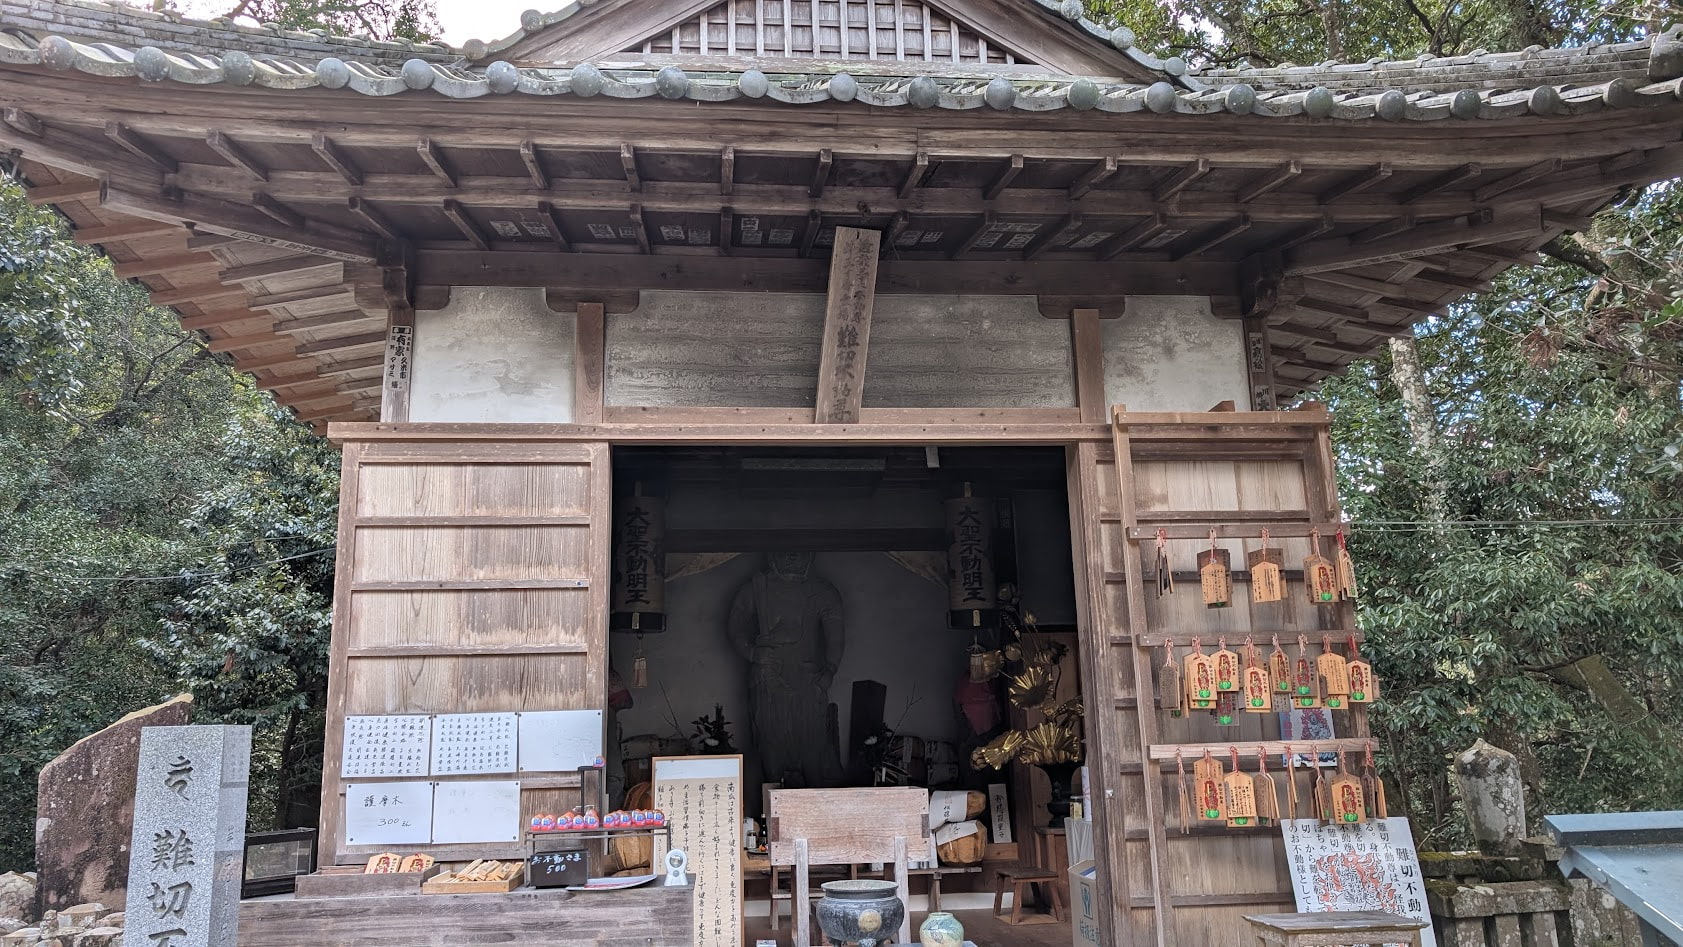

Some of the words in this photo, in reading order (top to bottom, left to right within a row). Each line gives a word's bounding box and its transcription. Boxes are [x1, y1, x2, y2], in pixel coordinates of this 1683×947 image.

[625, 506, 650, 605] 大聖不動明王
[958, 505, 986, 603] 大聖不動明王
[363, 794, 403, 808] 護摩木
[531, 852, 582, 866] お不動さま
[546, 864, 567, 874] 500
